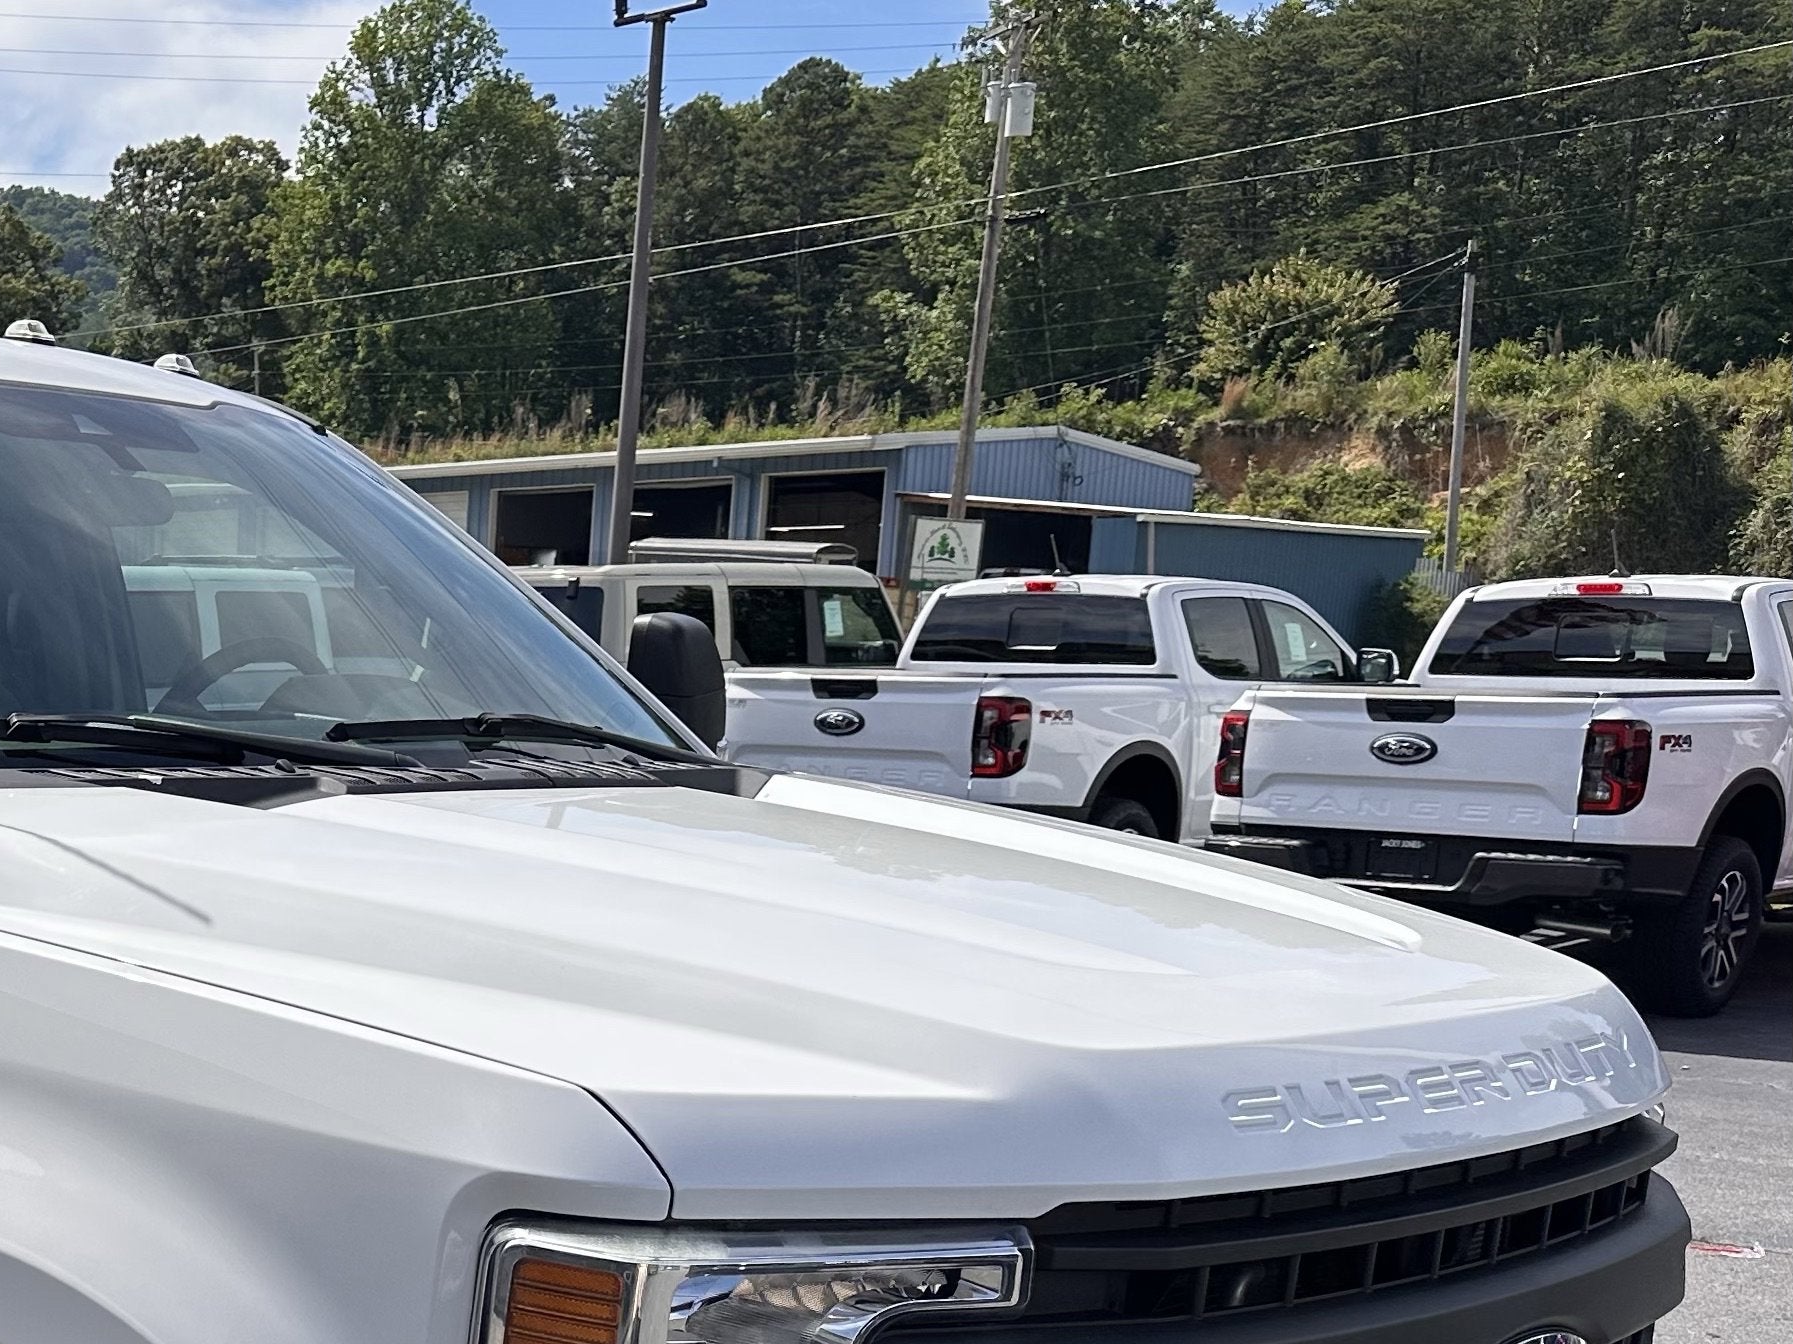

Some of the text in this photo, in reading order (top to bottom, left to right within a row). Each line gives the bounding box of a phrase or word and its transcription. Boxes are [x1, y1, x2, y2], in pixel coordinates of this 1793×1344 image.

[1039, 709, 1073, 724] FX4
[1659, 734, 1692, 751] FX4
[1269, 793, 1543, 825] RANGER
[1222, 1032, 1637, 1134] SUPER DUTY
